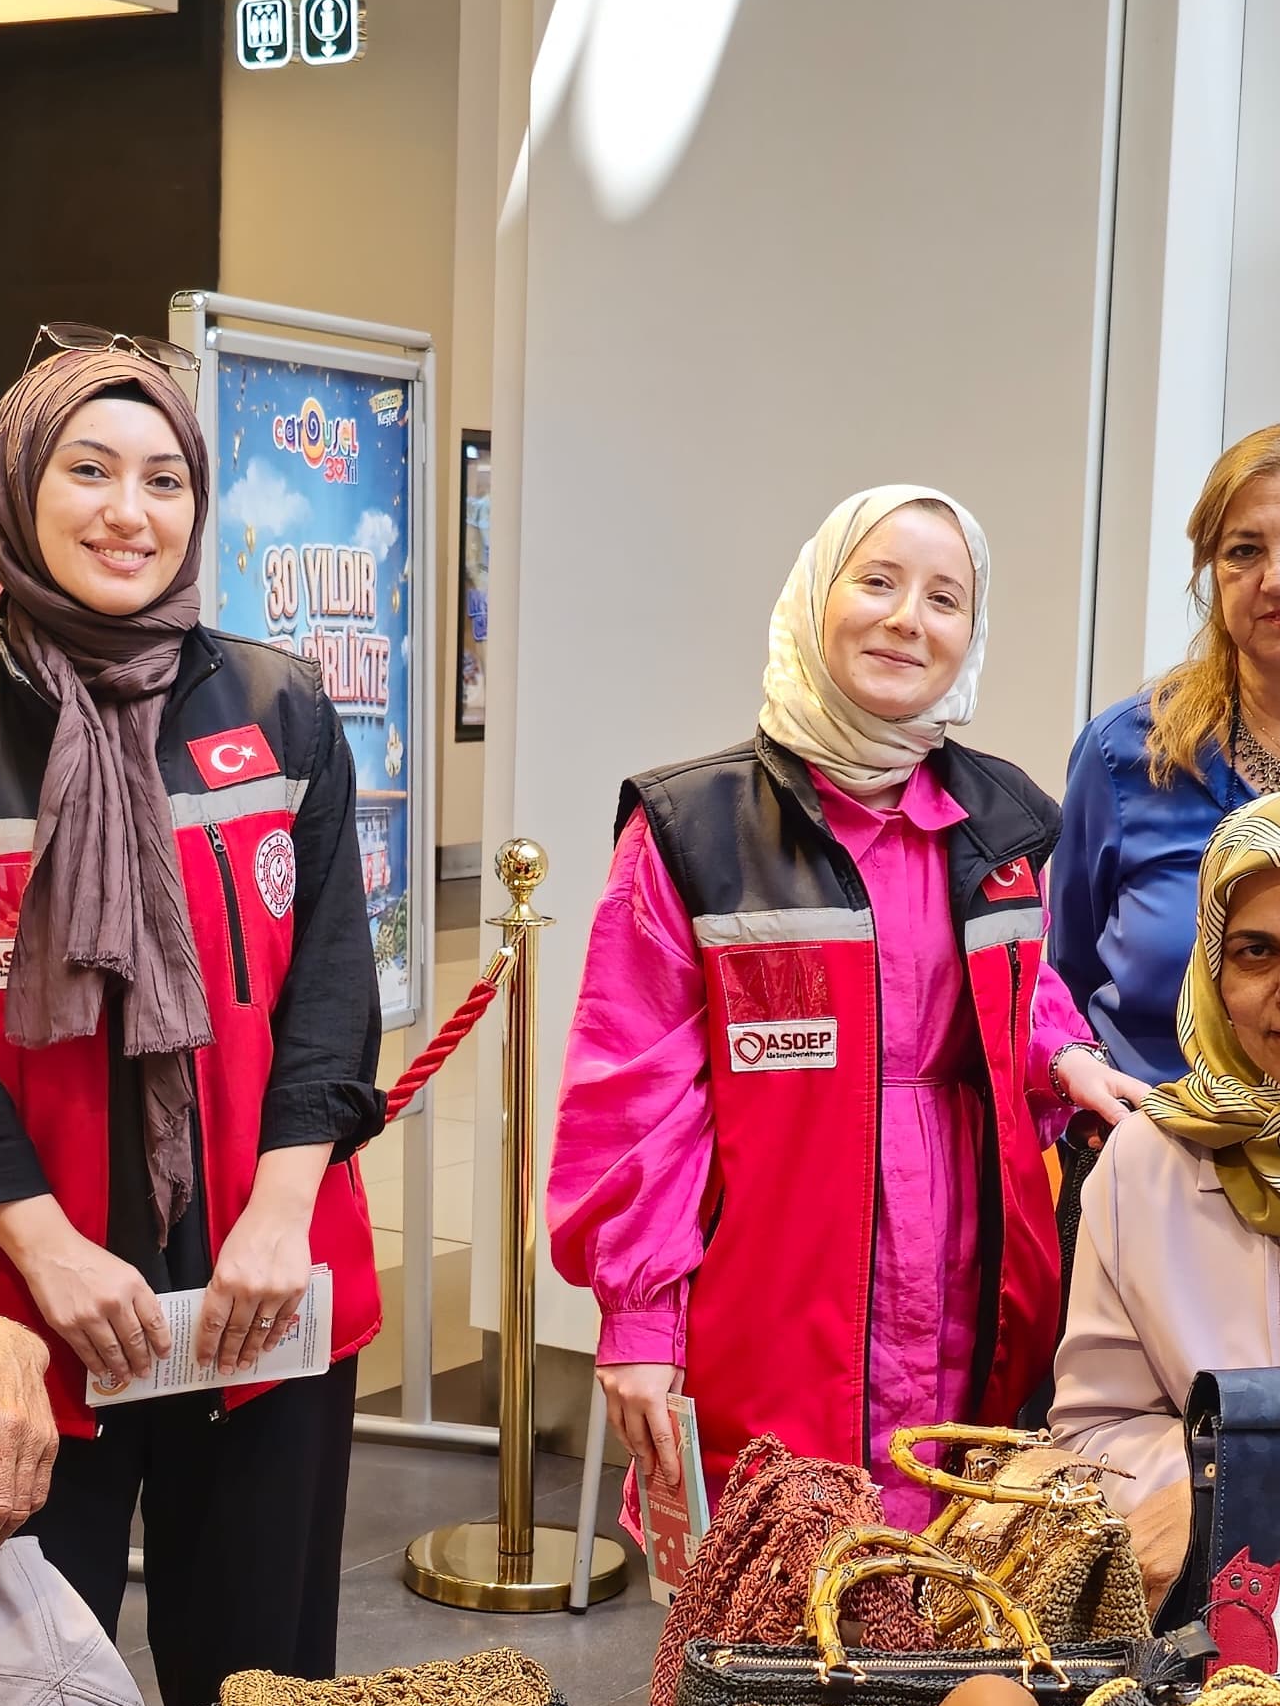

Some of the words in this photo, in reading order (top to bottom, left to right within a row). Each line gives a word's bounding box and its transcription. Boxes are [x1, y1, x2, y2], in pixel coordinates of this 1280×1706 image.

[267, 548, 299, 621] 30
[303, 546, 375, 618] YILDIR
[766, 1032, 832, 1050] ASDEP
